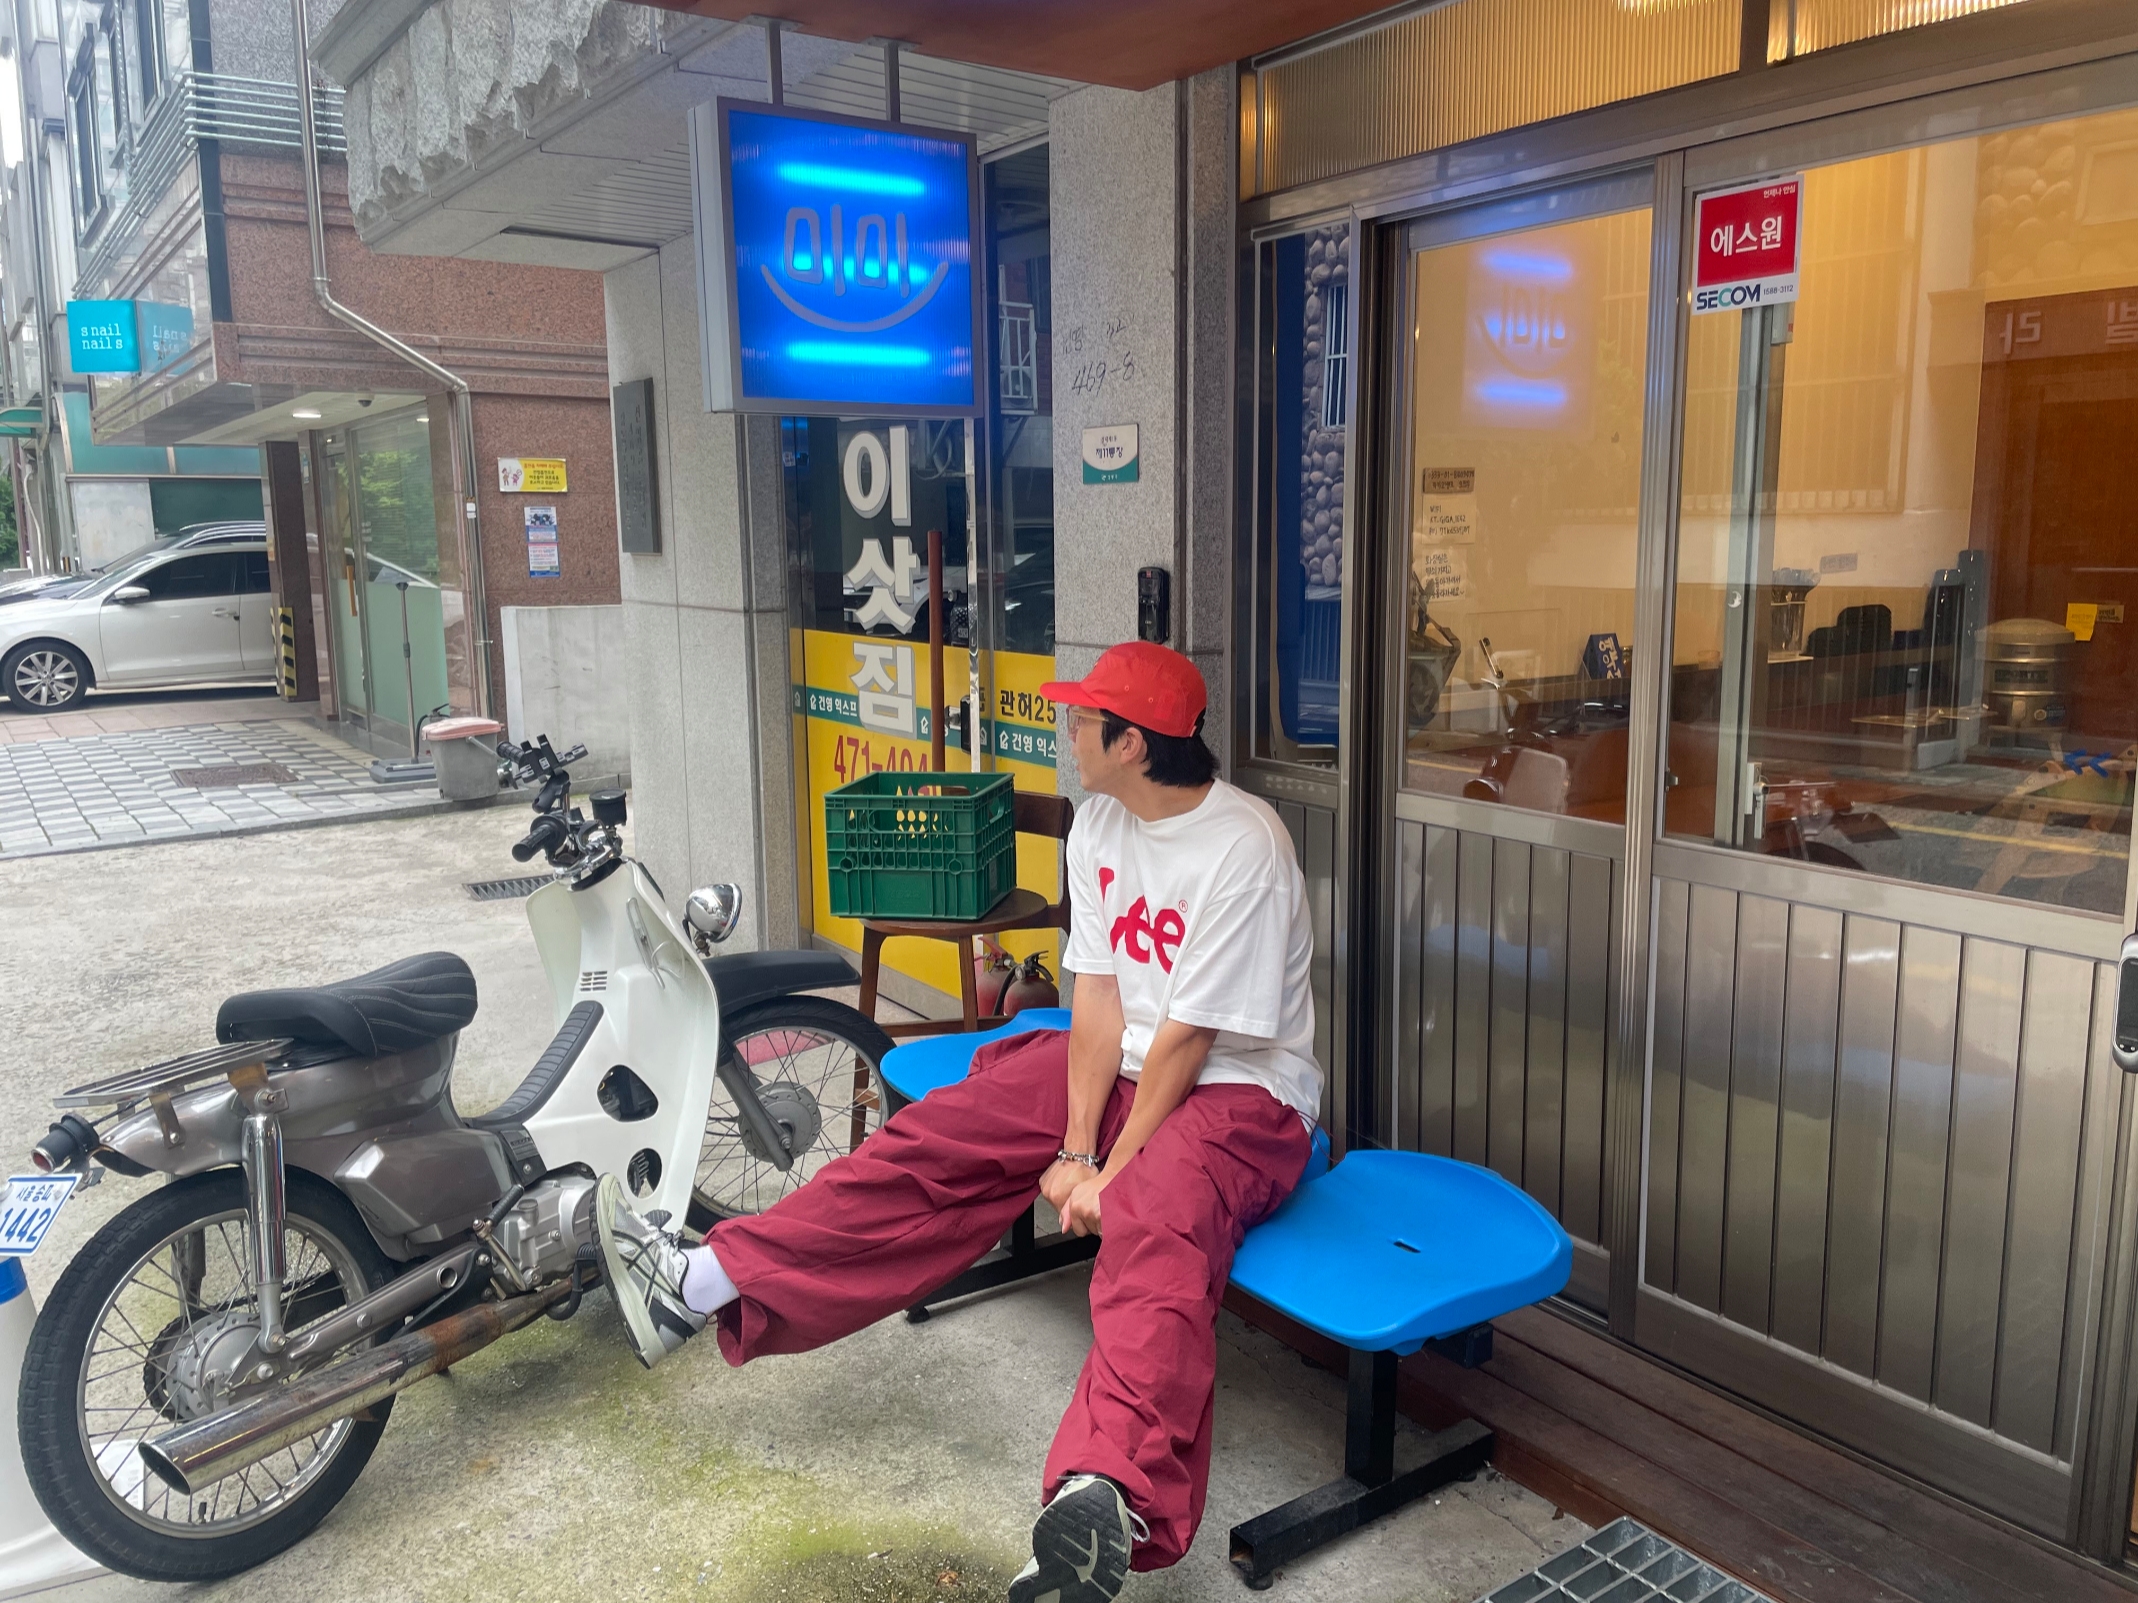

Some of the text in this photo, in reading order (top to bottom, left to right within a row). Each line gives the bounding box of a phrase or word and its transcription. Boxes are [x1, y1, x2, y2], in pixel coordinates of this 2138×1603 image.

[1710, 215, 1782, 257] 에스원
[784, 204, 910, 298] 미미
[1697, 284, 1761, 311] SECOM
[81, 323, 122, 337] snail
[82, 336, 124, 350] nails
[843, 424, 920, 740] 이삿짐
[818, 695, 858, 717] 건영 익스프
[1012, 732, 1057, 759] 건영 익스
[0, 1207, 52, 1243] 1442
